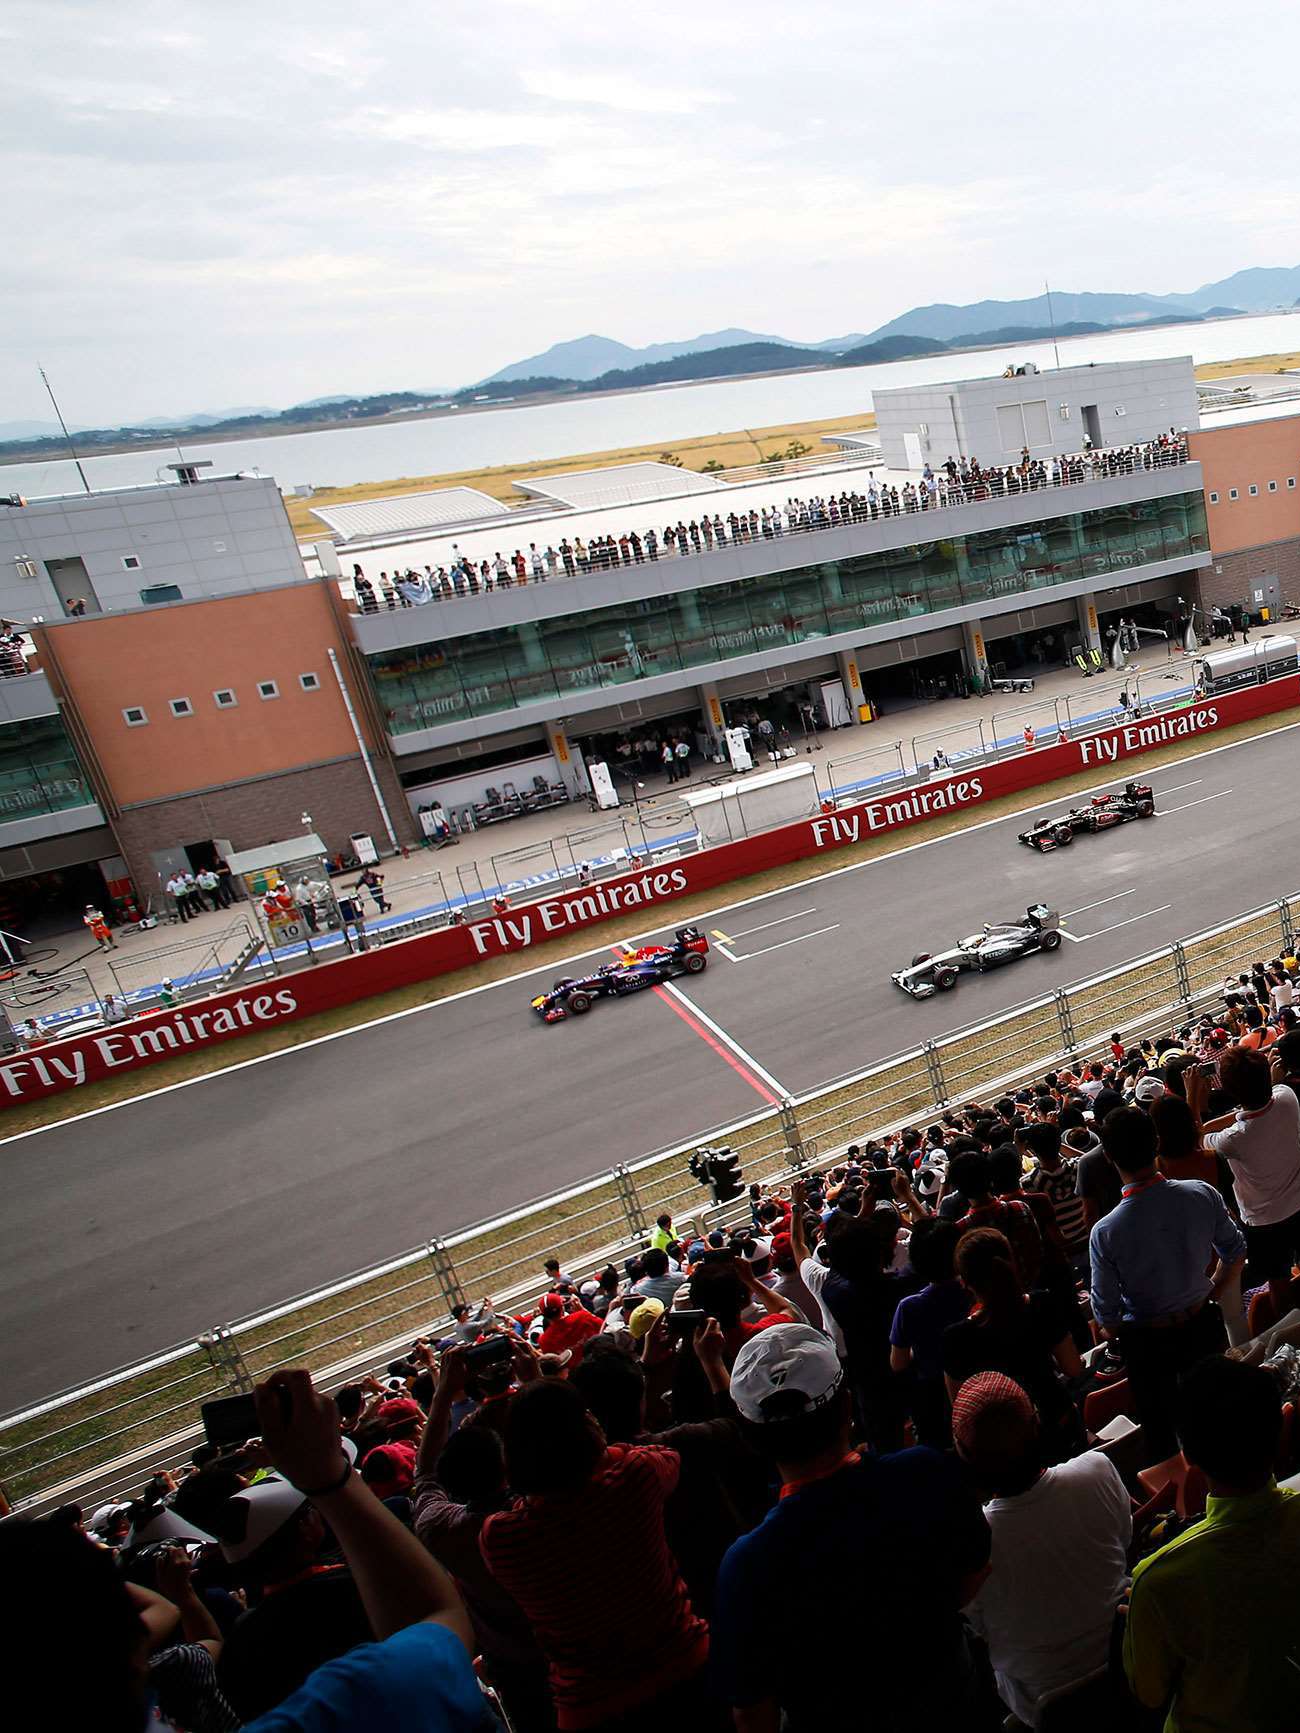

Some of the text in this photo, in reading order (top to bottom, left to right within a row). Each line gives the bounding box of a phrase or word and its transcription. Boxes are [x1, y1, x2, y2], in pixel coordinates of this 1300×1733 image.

[1079, 707, 1219, 764] Fly Emirates
[811, 778, 983, 847] Fly Emirates
[280, 925, 298, 938] 10
[468, 868, 688, 955] Fly Emirates
[0, 1050, 86, 1097] Fly
[93, 989, 298, 1067] Emirates
